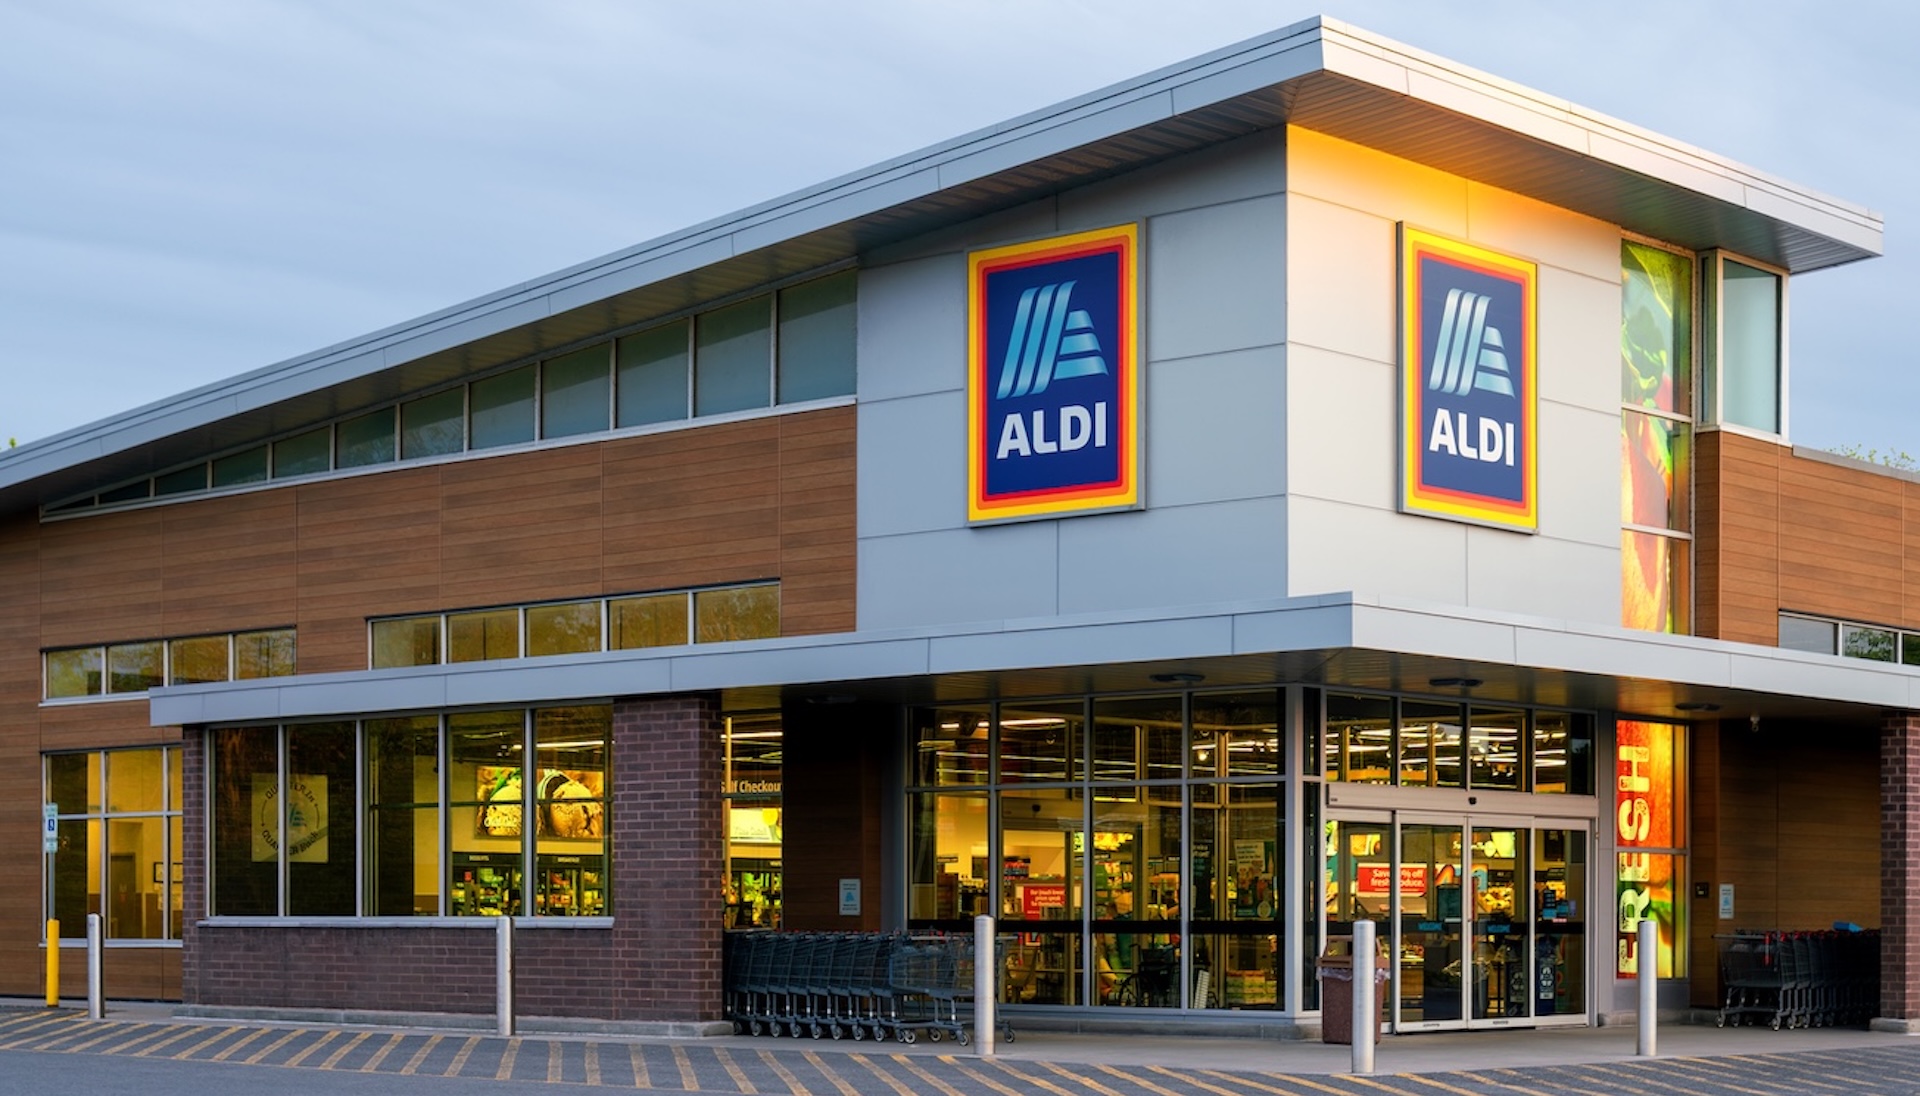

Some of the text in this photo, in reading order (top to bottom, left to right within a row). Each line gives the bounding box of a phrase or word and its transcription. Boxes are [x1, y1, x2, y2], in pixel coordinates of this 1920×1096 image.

[996, 401, 1107, 460] ALDI
[1429, 407, 1515, 467] ALDI
[739, 780, 782, 793] Checkou
